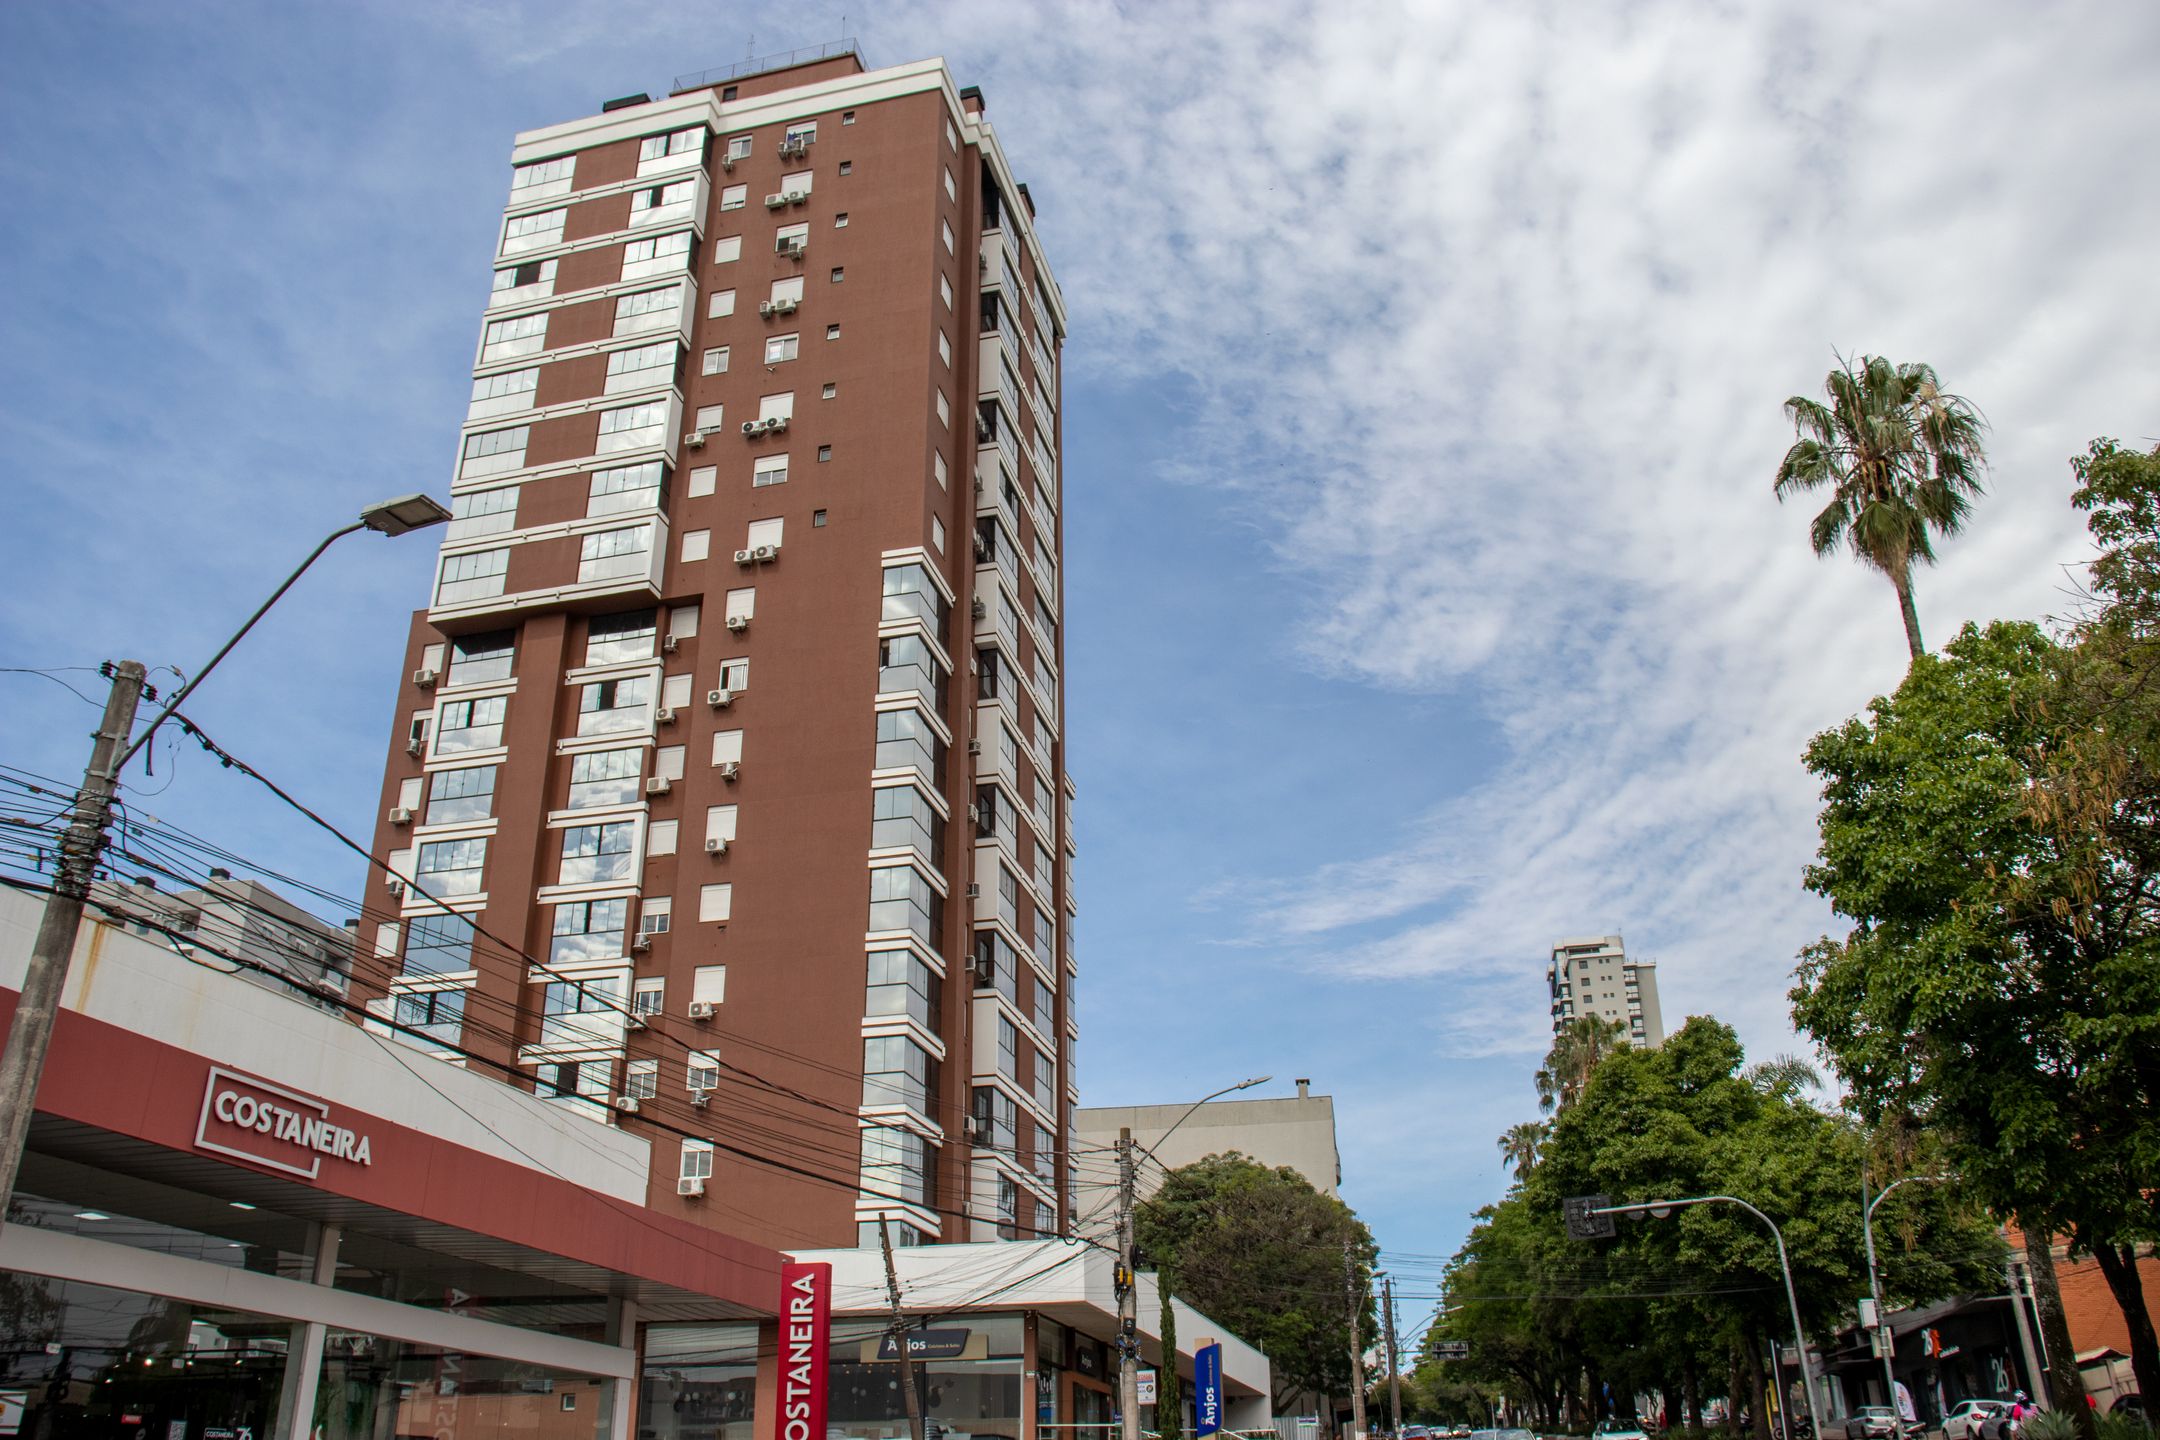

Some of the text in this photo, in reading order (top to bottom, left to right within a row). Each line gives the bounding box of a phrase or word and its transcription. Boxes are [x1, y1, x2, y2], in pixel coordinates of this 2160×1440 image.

[215, 1090, 371, 1166] COSTANEIRA
[887, 1338, 926, 1353] Ajos
[1204, 1386, 1218, 1426] Anjos
